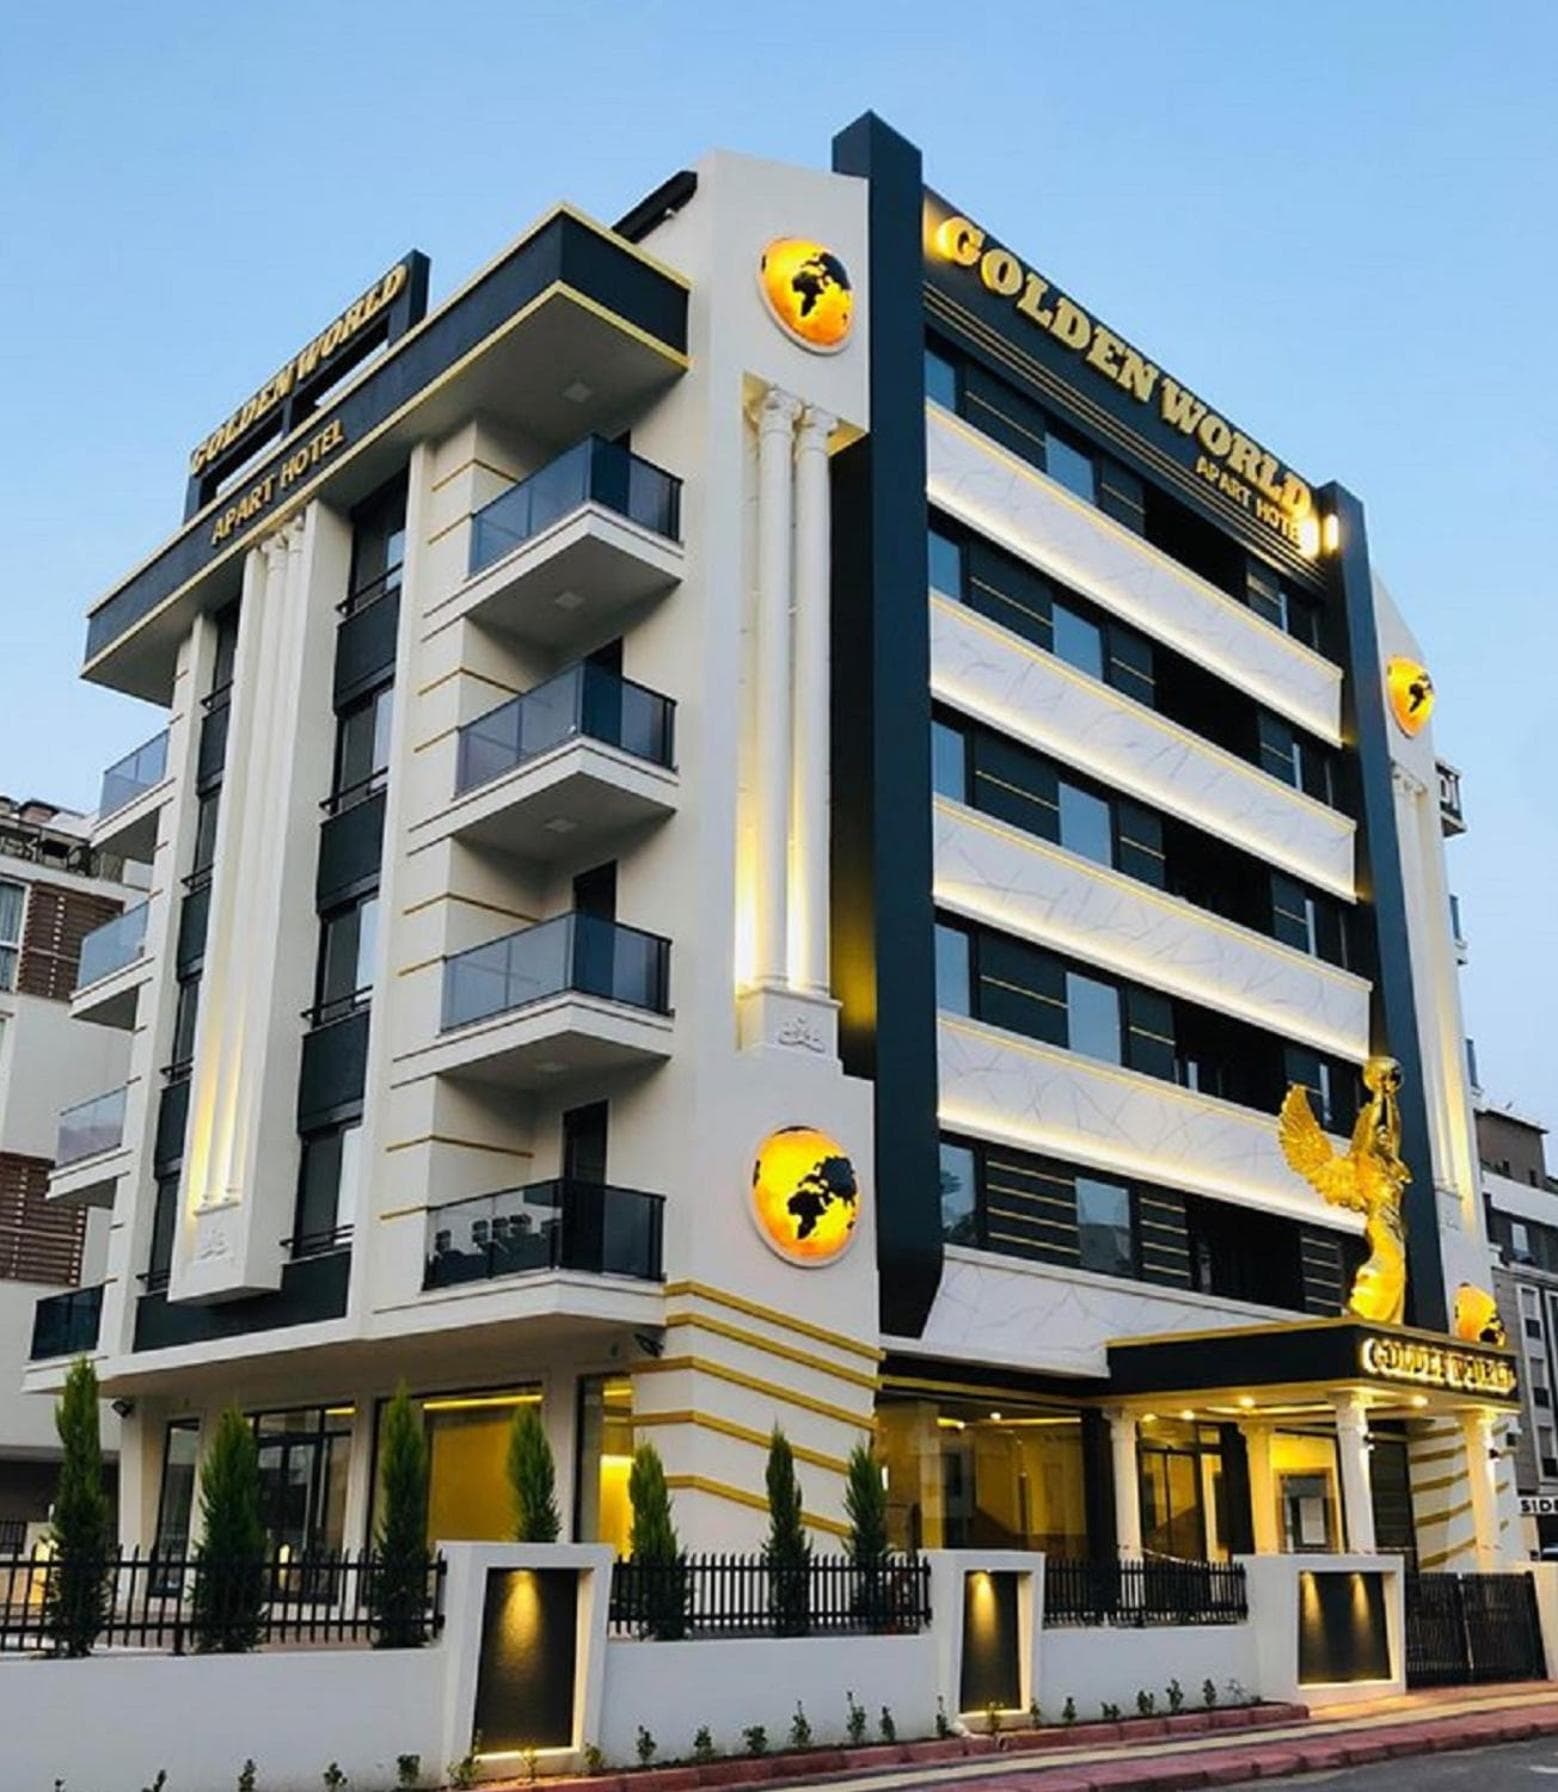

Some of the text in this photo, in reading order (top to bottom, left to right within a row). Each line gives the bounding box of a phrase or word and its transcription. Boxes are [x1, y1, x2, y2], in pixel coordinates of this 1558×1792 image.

[191, 264, 408, 477] GOLDEN WORLD
[938, 215, 1312, 518] GOLDEN WORLD
[211, 419, 345, 546] APART HOTEL
[1196, 455, 1310, 552] APART HOTE
